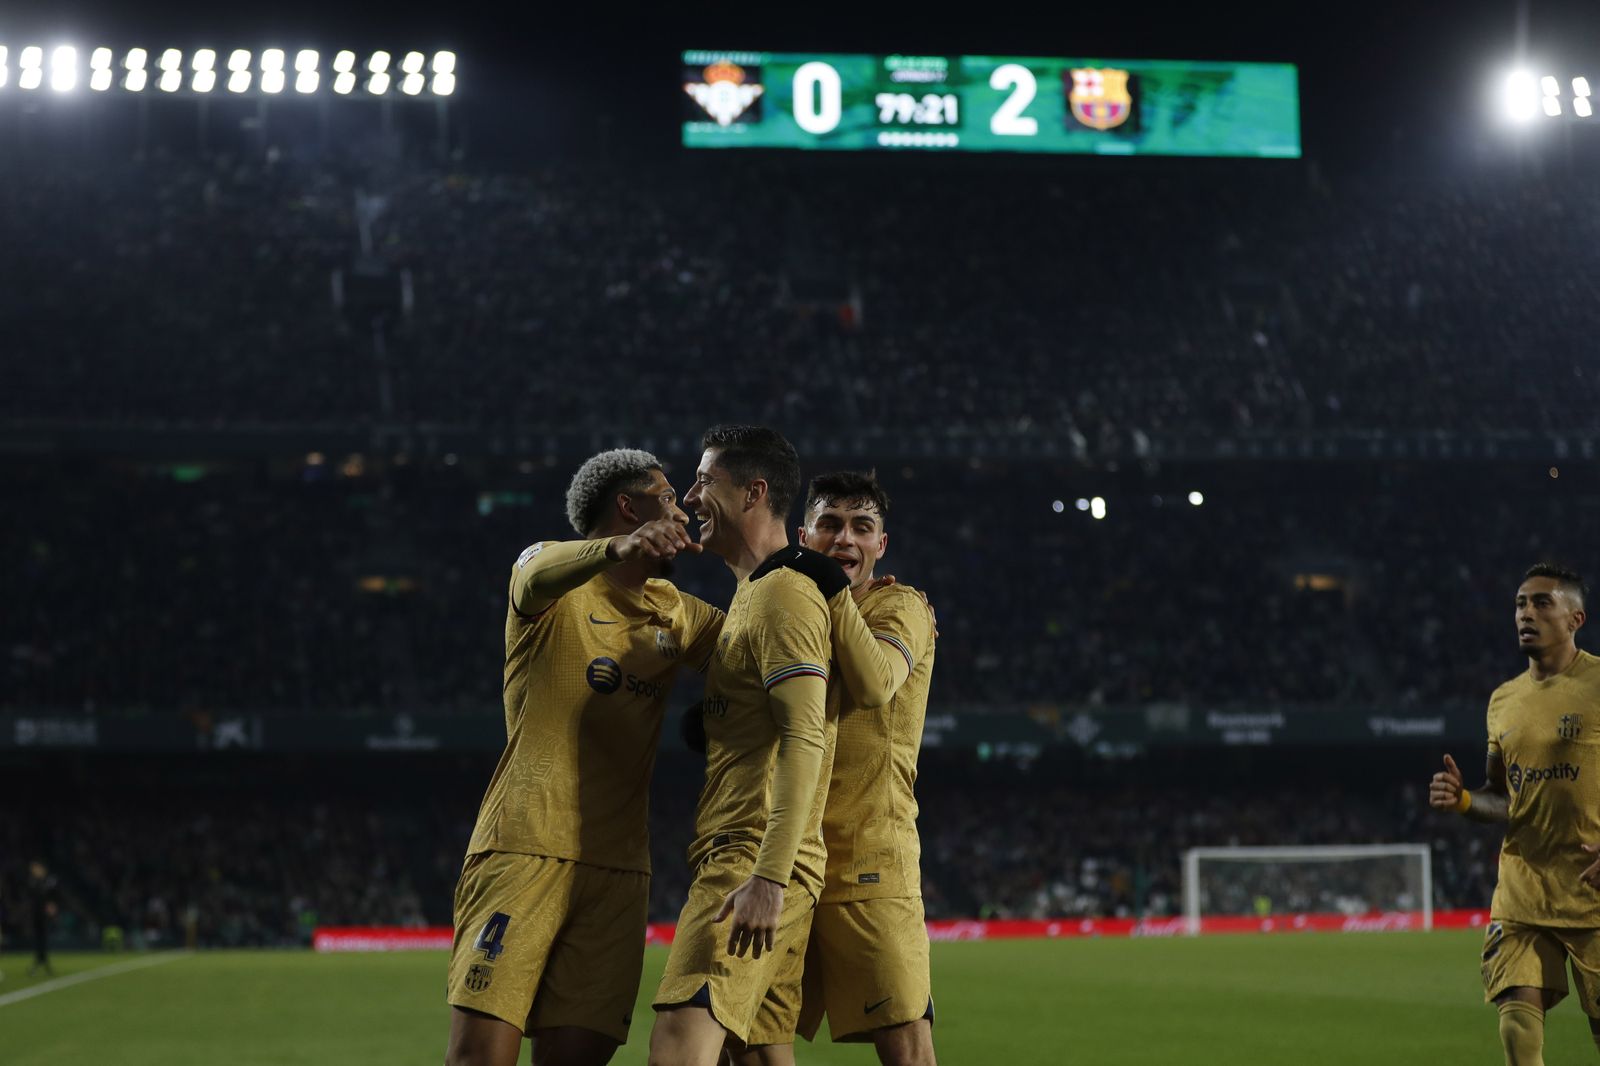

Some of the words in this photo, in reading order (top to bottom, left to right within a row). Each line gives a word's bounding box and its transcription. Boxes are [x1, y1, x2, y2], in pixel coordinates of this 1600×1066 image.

[793, 62, 842, 134] 0
[875, 93, 959, 124] 79:21
[989, 63, 1038, 136] 2
[1525, 763, 1580, 784] Spotify
[473, 911, 511, 962] 4
